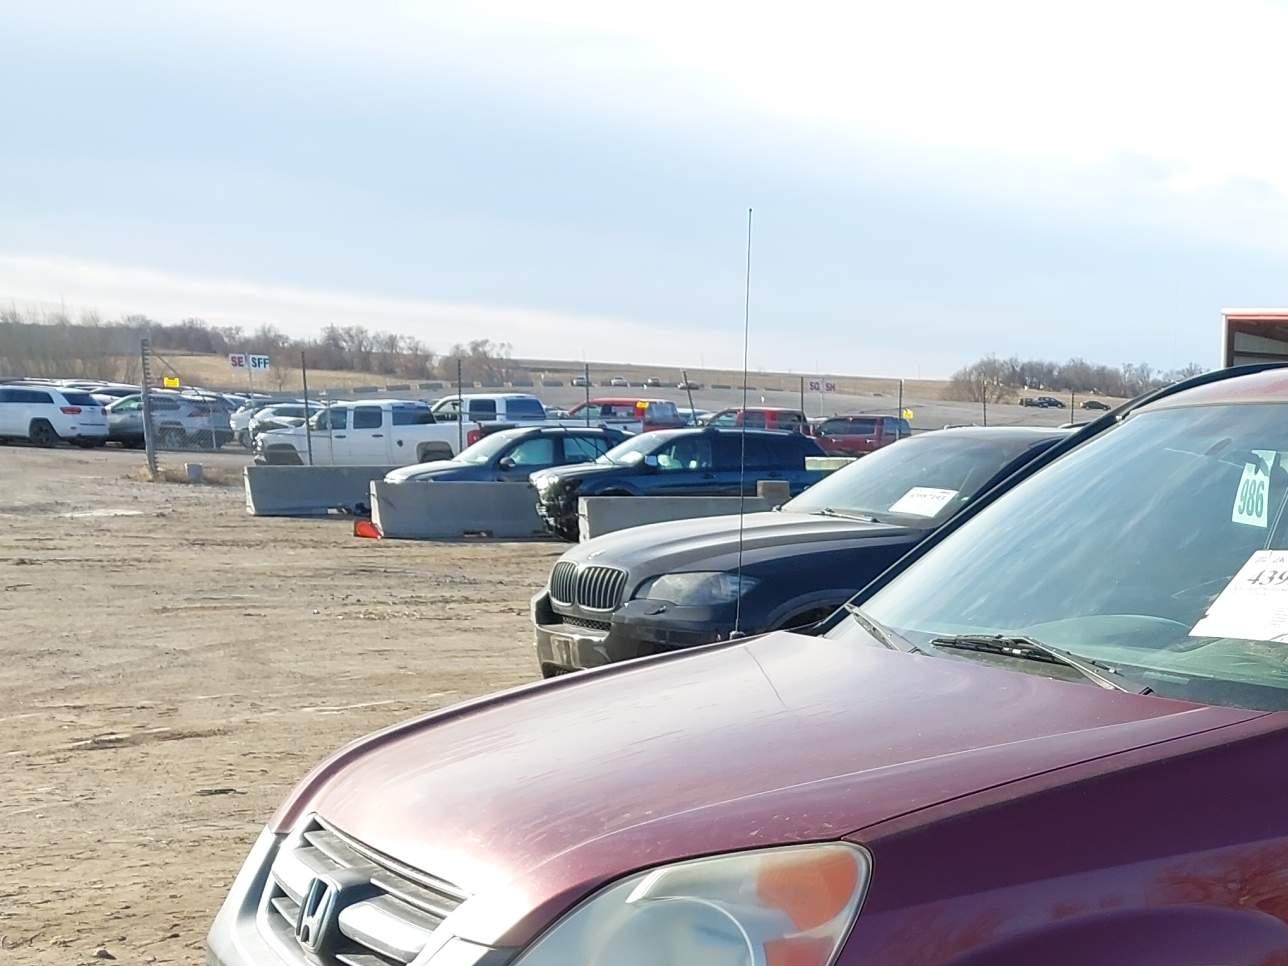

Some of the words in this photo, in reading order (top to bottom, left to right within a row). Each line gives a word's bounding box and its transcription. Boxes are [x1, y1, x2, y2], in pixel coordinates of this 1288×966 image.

[231, 355, 244, 367] SE
[251, 356, 270, 368] SFF
[1238, 479, 1264, 518] 986
